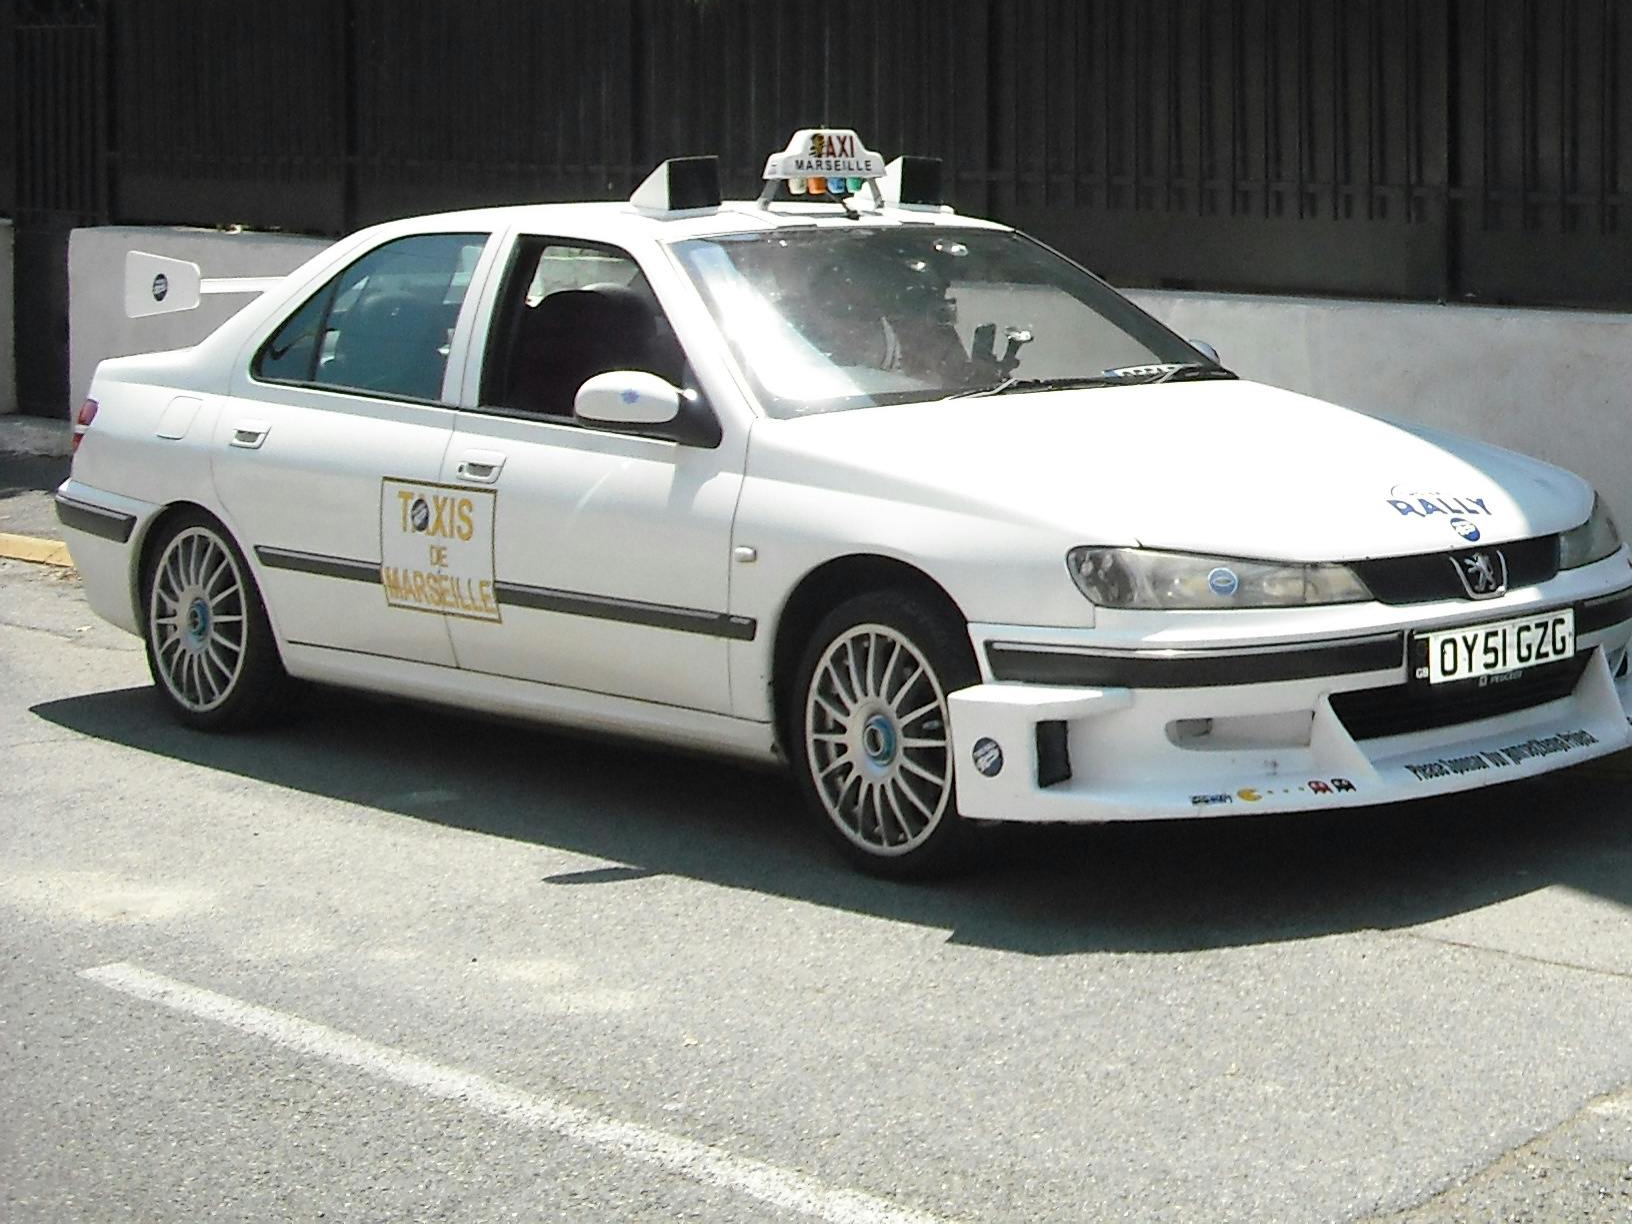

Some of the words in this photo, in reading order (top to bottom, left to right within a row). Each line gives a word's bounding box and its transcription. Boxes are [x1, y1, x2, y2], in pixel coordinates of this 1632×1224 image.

[809, 133, 855, 158] AXI
[795, 159, 873, 172] MARSEILLE
[1386, 497, 1493, 518] RALLY
[430, 545, 449, 568] DE
[385, 566, 497, 614] MARSEILLE
[1440, 628, 1508, 677] OY51
[1516, 617, 1567, 663] GZG
